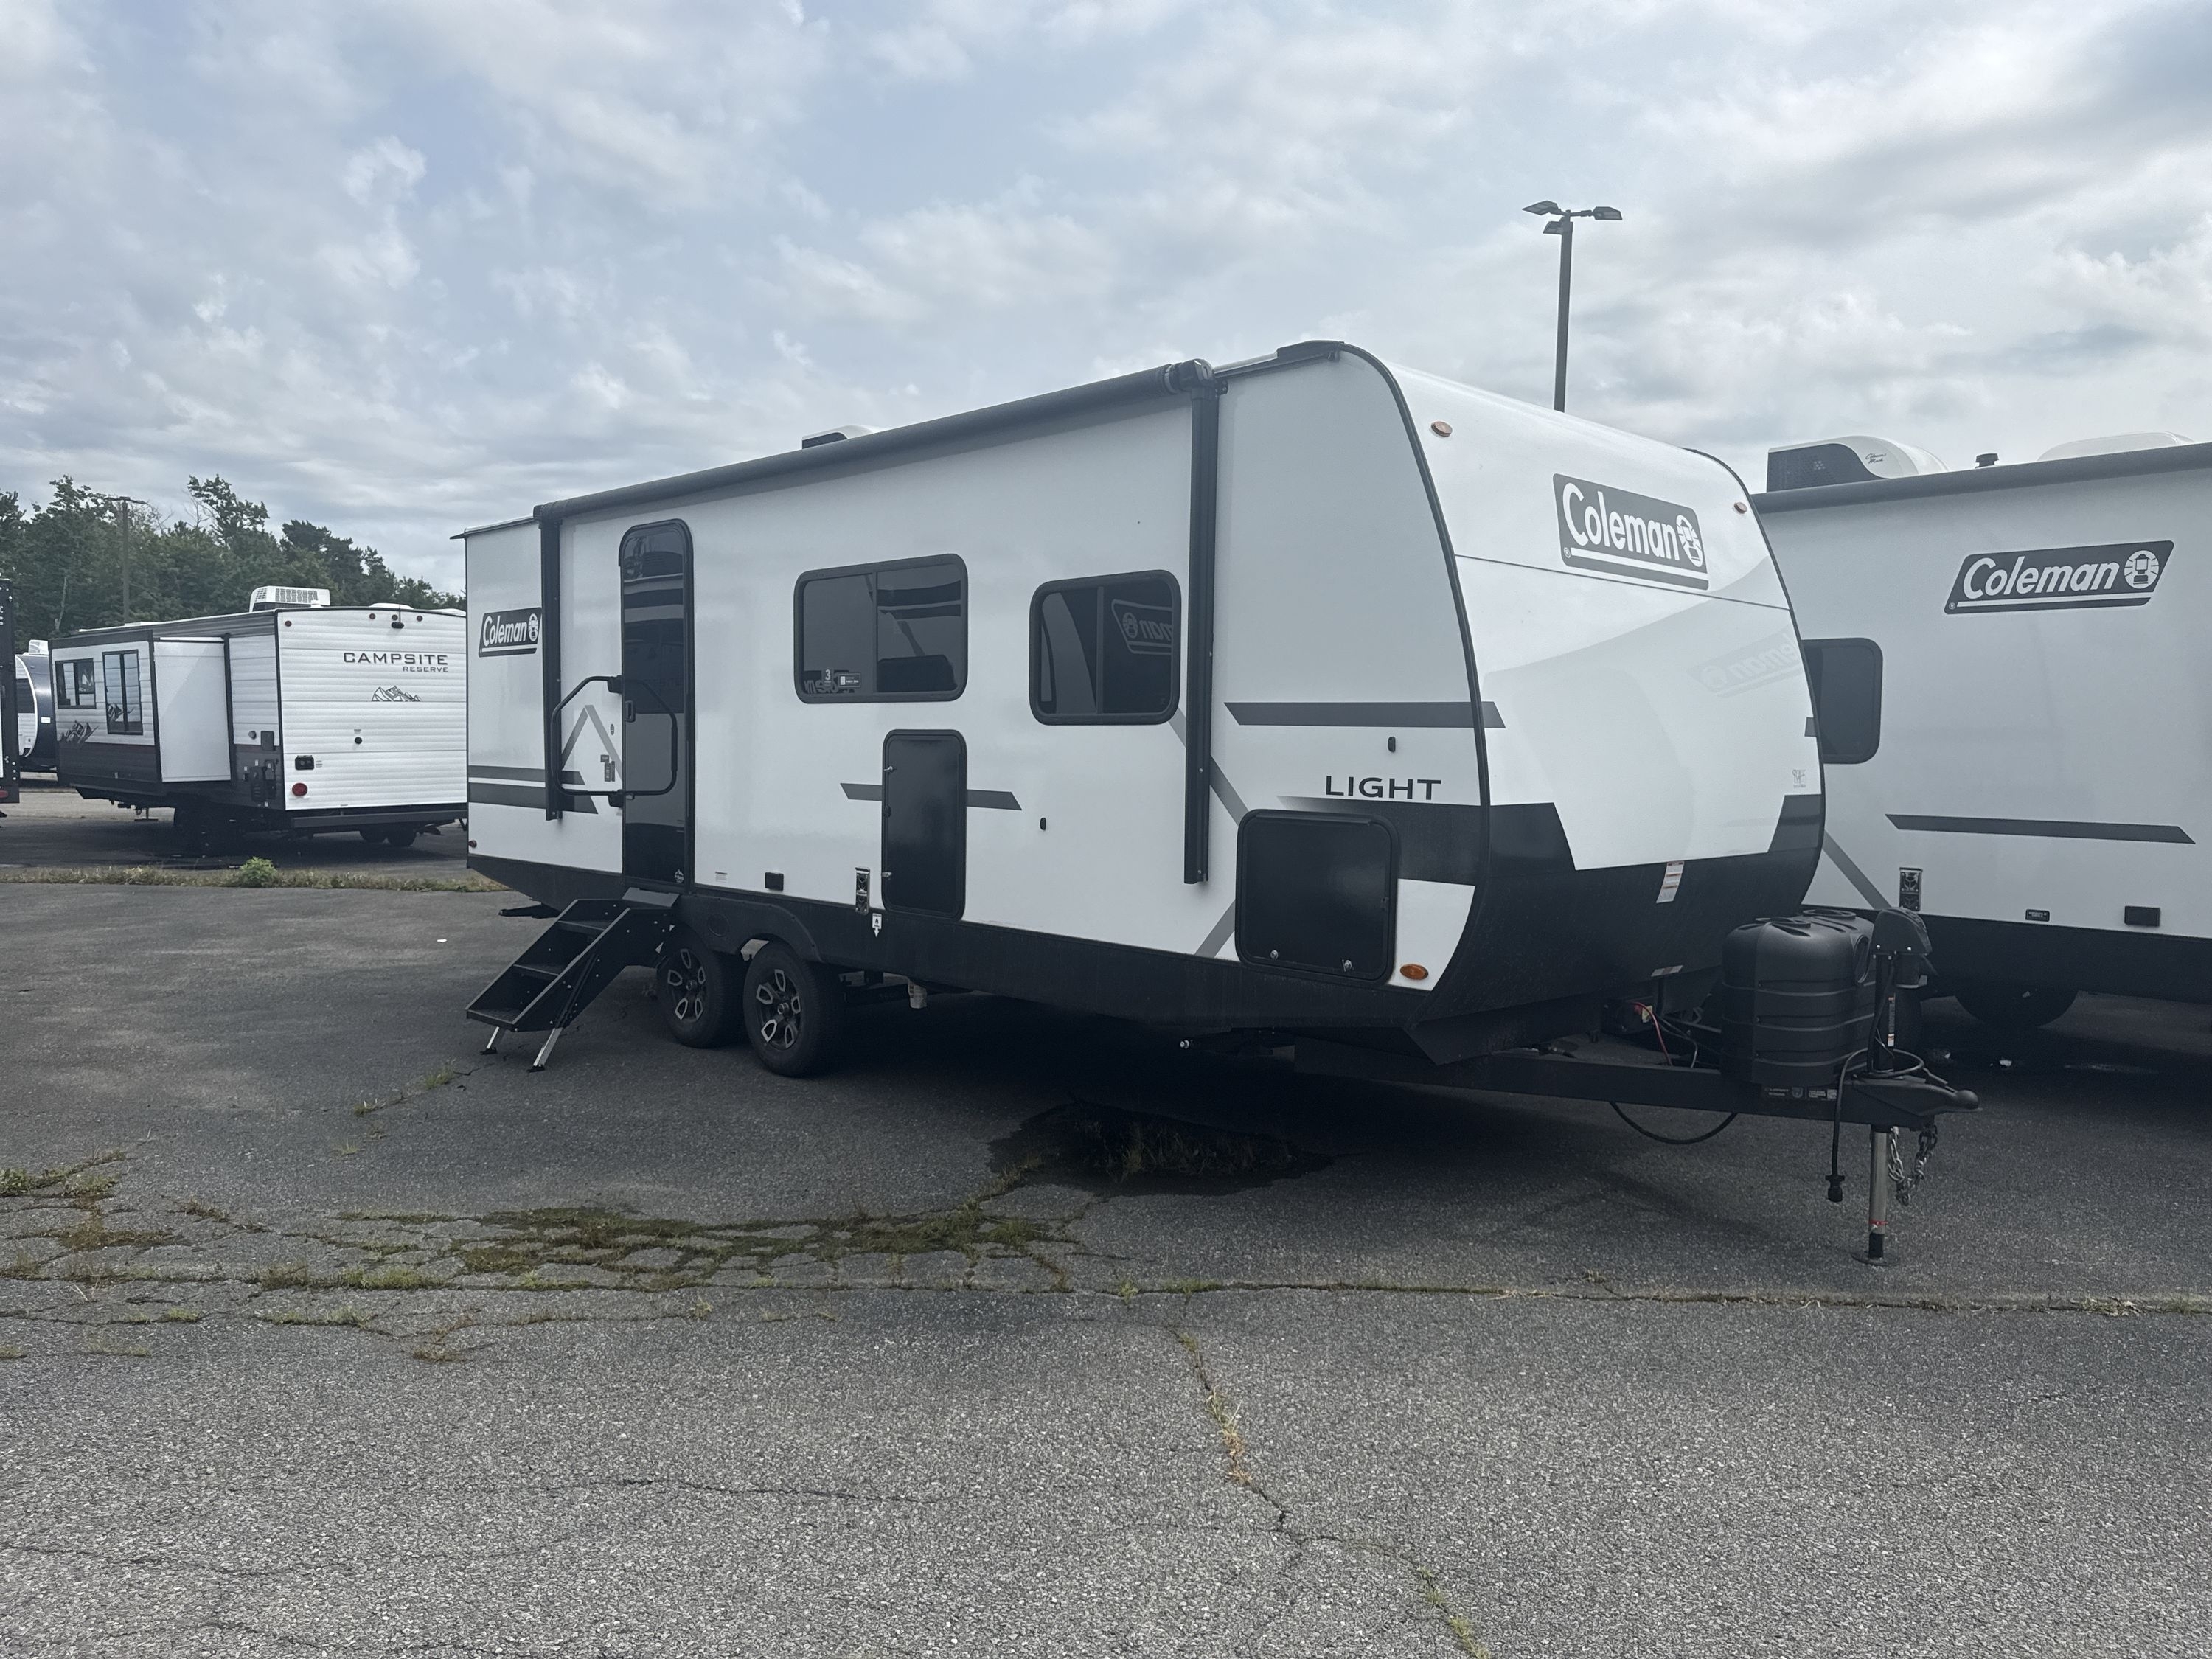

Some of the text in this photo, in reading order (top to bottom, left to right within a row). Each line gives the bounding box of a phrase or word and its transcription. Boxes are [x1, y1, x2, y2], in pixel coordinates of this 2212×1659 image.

[1562, 483, 1680, 560] Coleman
[1964, 556, 2120, 599] Coleman
[483, 616, 527, 647] Coleman
[344, 653, 448, 665] CAMPSITE
[825, 669, 831, 681] 3
[1326, 776, 1441, 800] LIGHT
